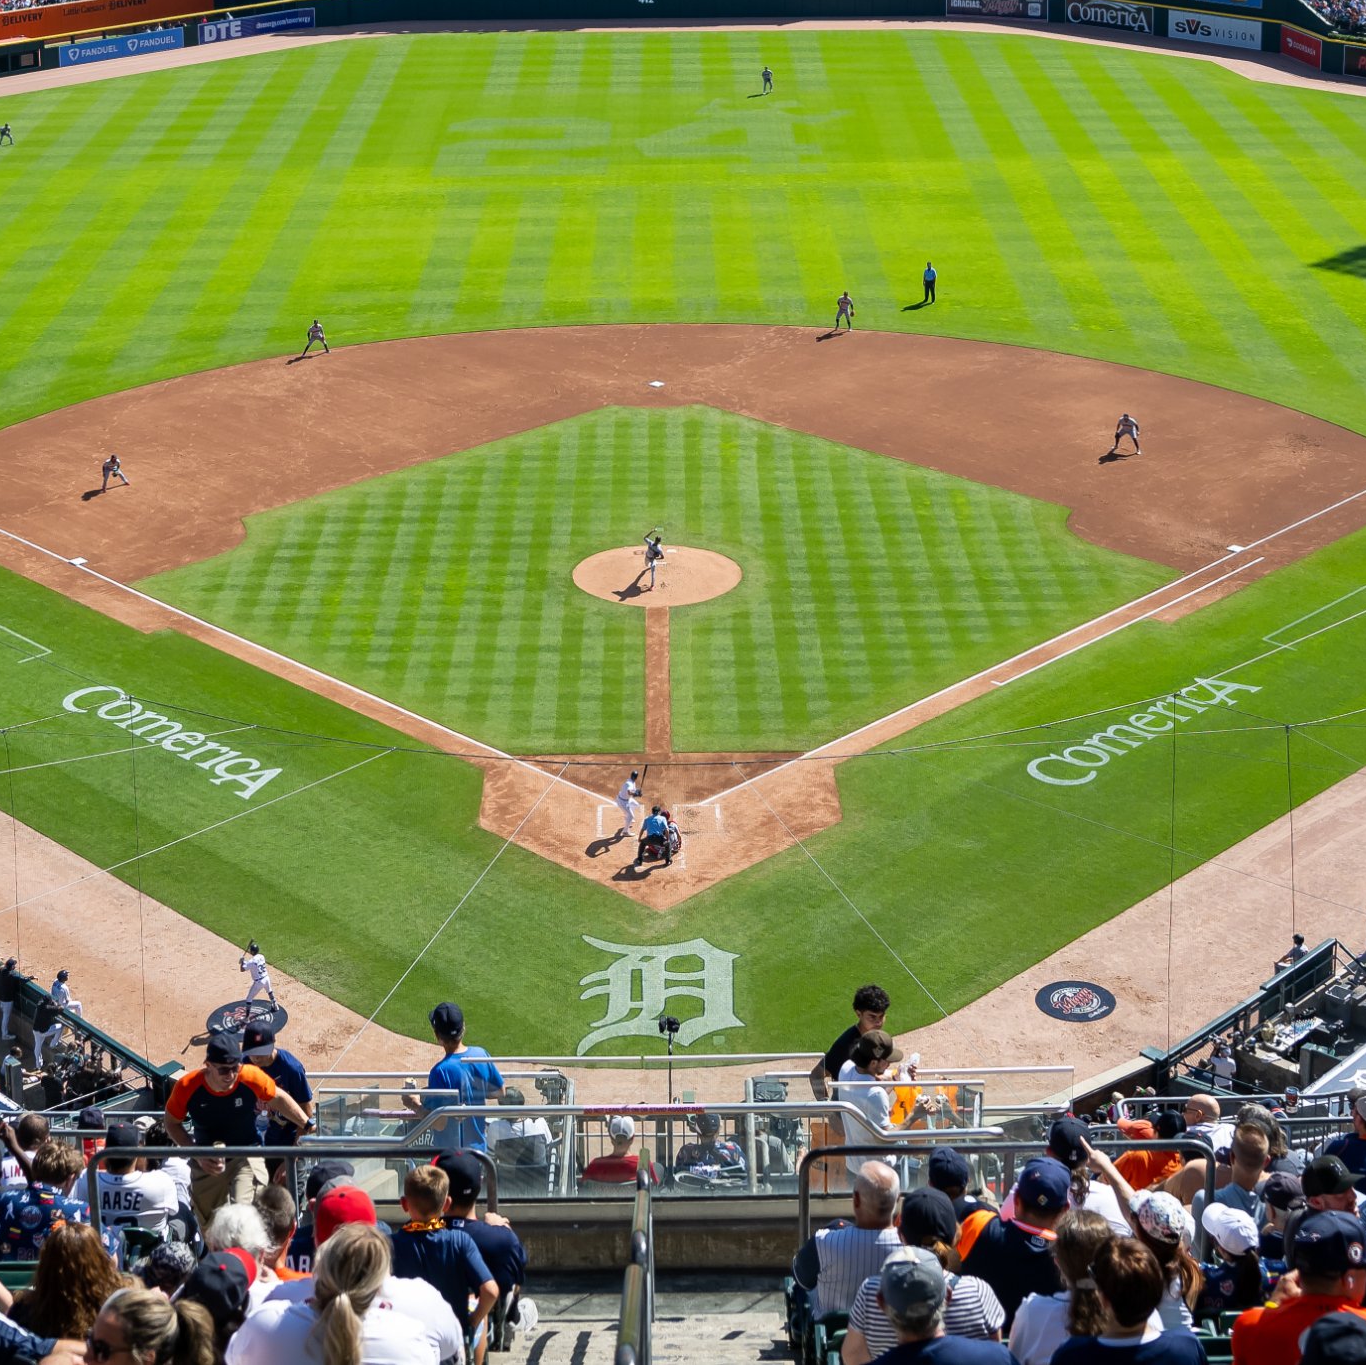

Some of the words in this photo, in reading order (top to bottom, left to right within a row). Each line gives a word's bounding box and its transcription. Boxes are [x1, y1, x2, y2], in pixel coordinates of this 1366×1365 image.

[203, 20, 242, 42] DTE
[1214, 28, 1256, 43] VISION
[139, 36, 176, 48] FANDUEL
[81, 44, 119, 58] FANDUEL
